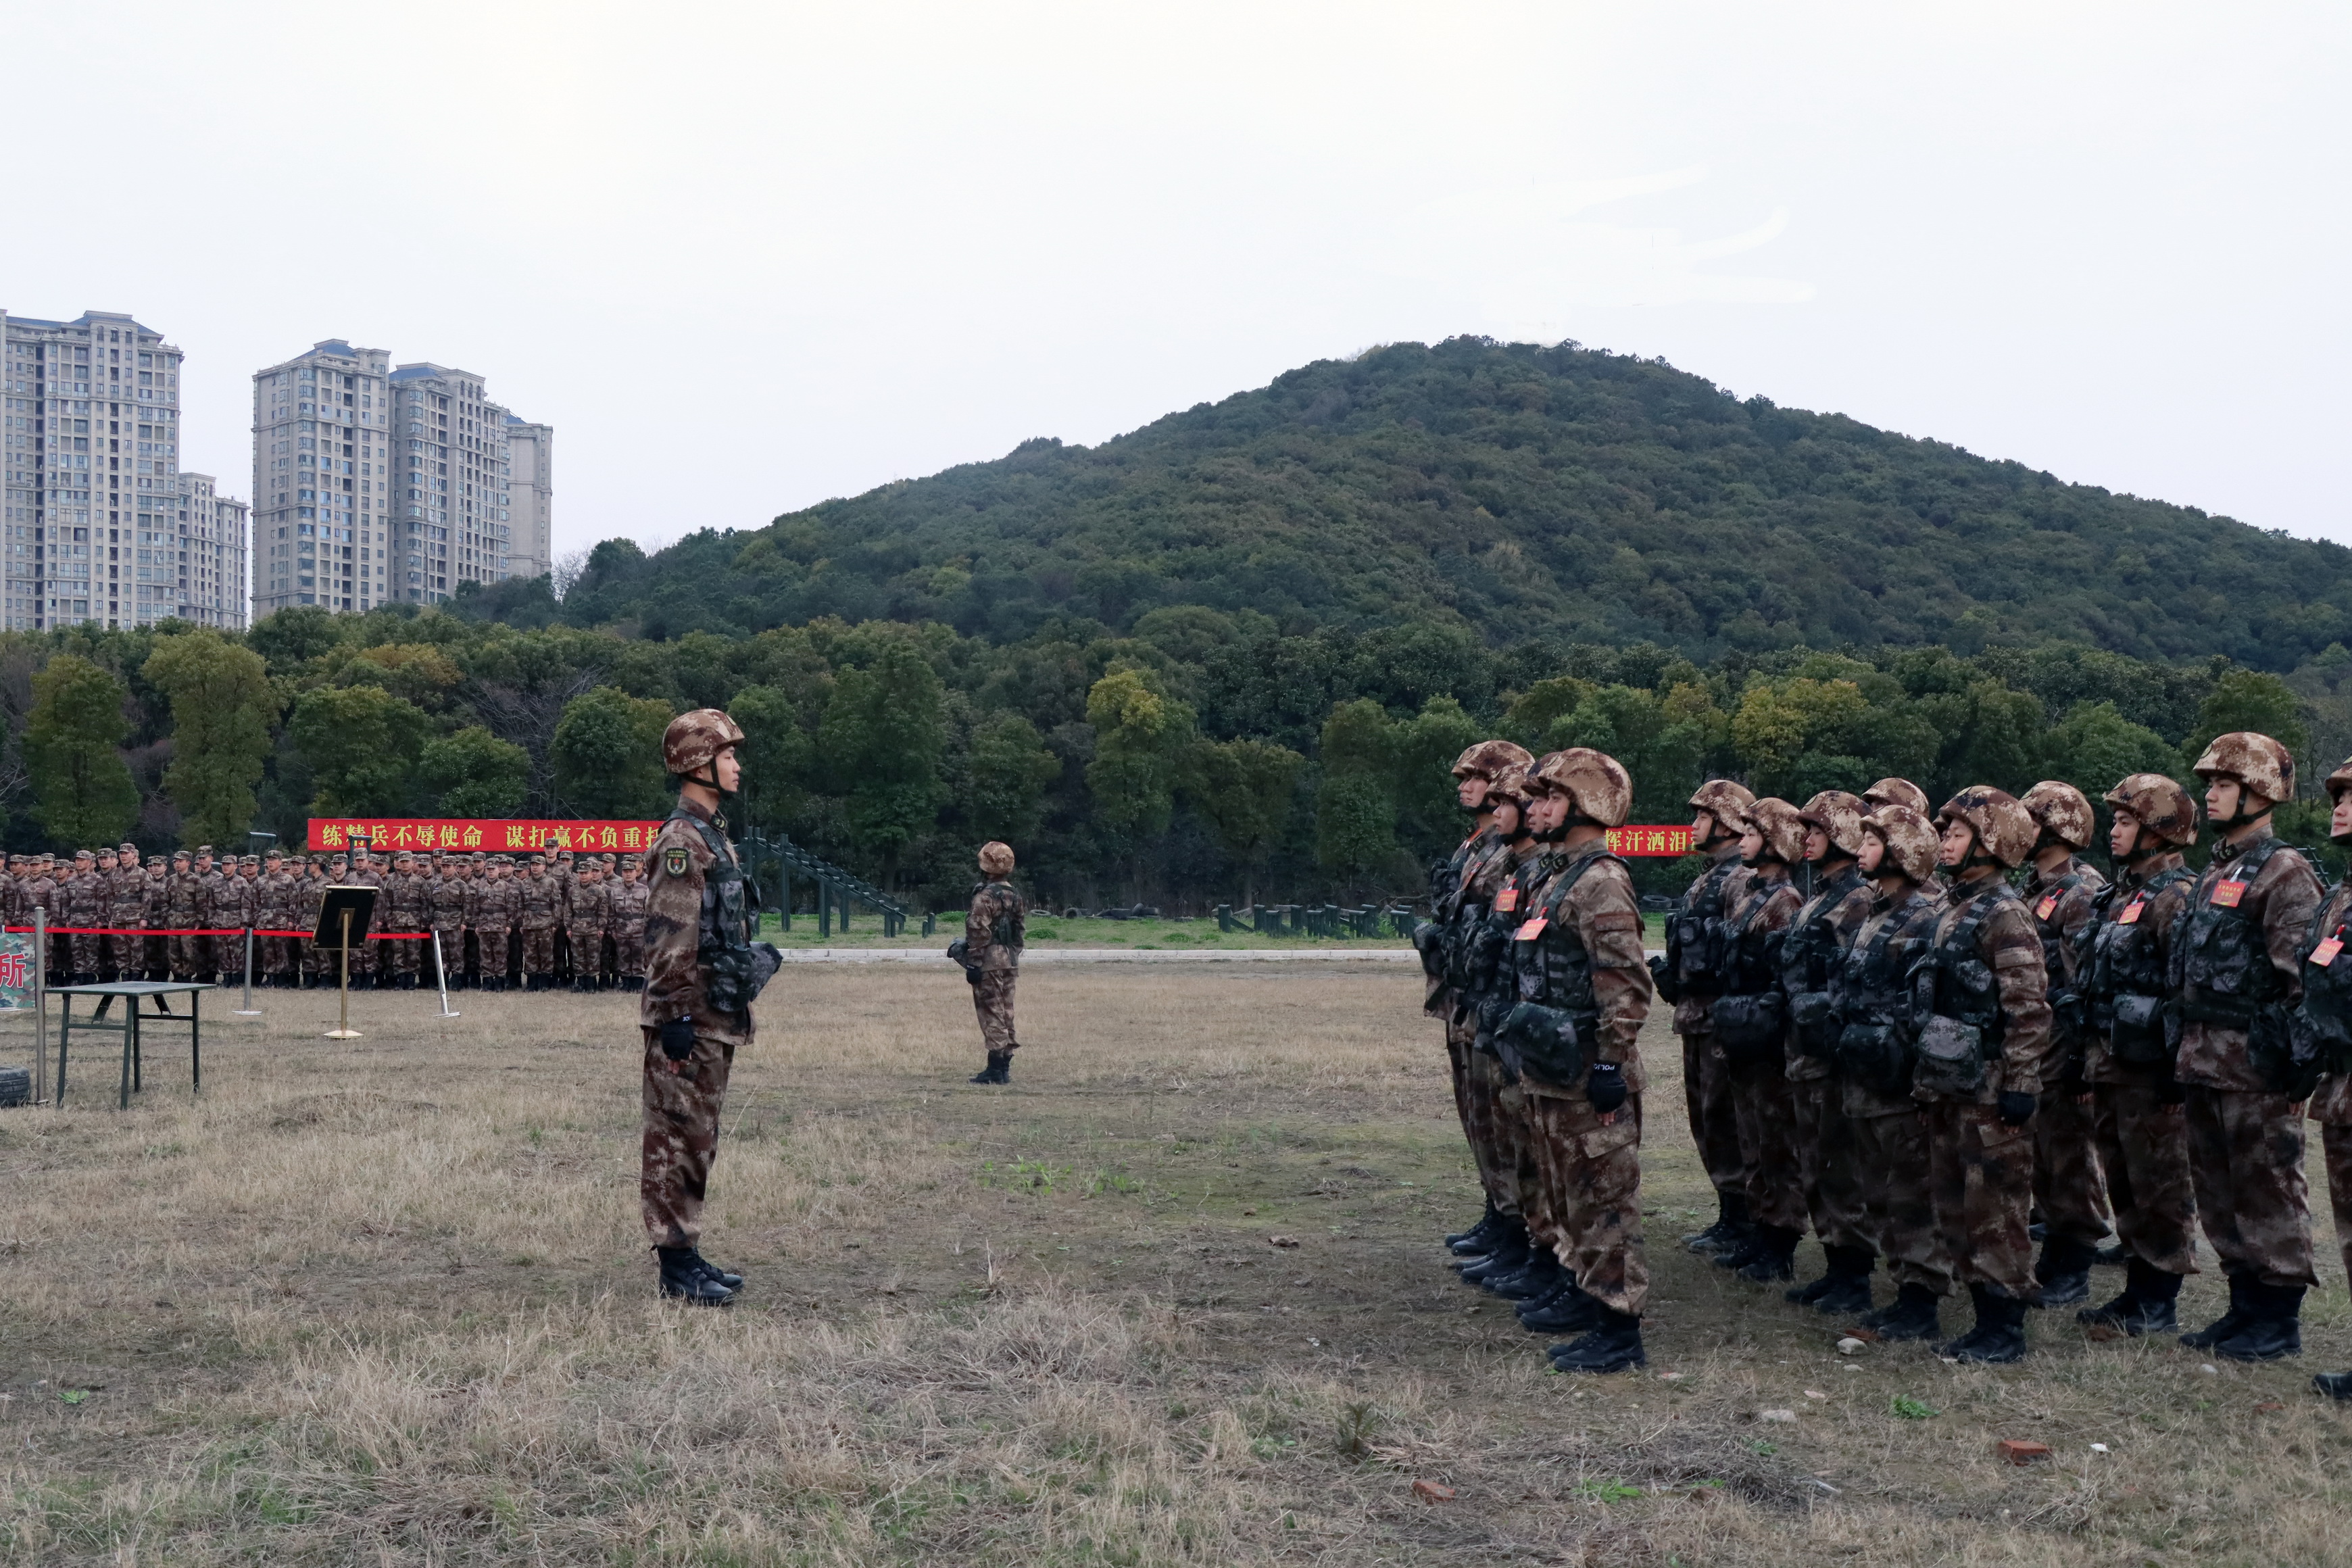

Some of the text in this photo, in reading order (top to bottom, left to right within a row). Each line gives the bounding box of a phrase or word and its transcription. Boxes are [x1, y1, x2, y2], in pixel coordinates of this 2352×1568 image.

[322, 824, 483, 847] 练精兵不辱使命
[1604, 829, 1696, 852] 挥汗洒泪
[0, 952, 26, 988] 所
